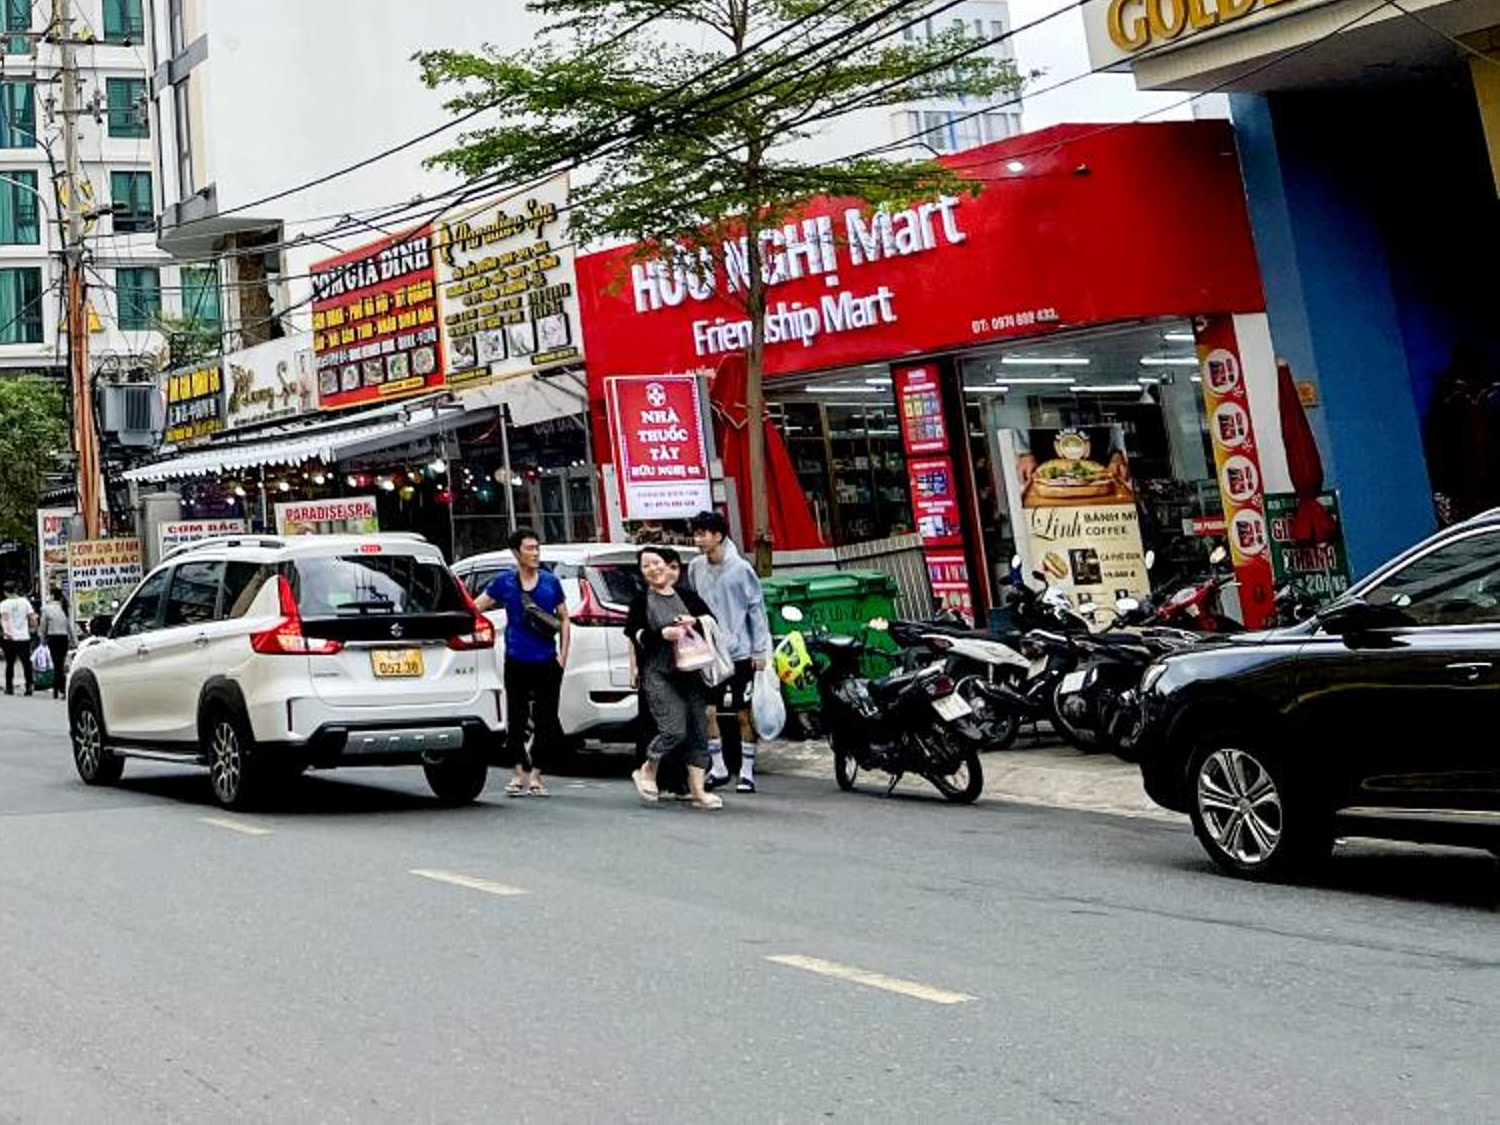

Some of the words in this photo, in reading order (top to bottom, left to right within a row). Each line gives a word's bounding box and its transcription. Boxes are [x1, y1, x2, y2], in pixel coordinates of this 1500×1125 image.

[844, 194, 967, 266] Mart
[692, 302, 820, 355] Frienship
[821, 286, 899, 329] Mart
[640, 407, 680, 424] NHÀ
[637, 425, 688, 442] THUỐC
[285, 503, 344, 522] PARADISE
[1085, 526, 1129, 536] COFFEE
